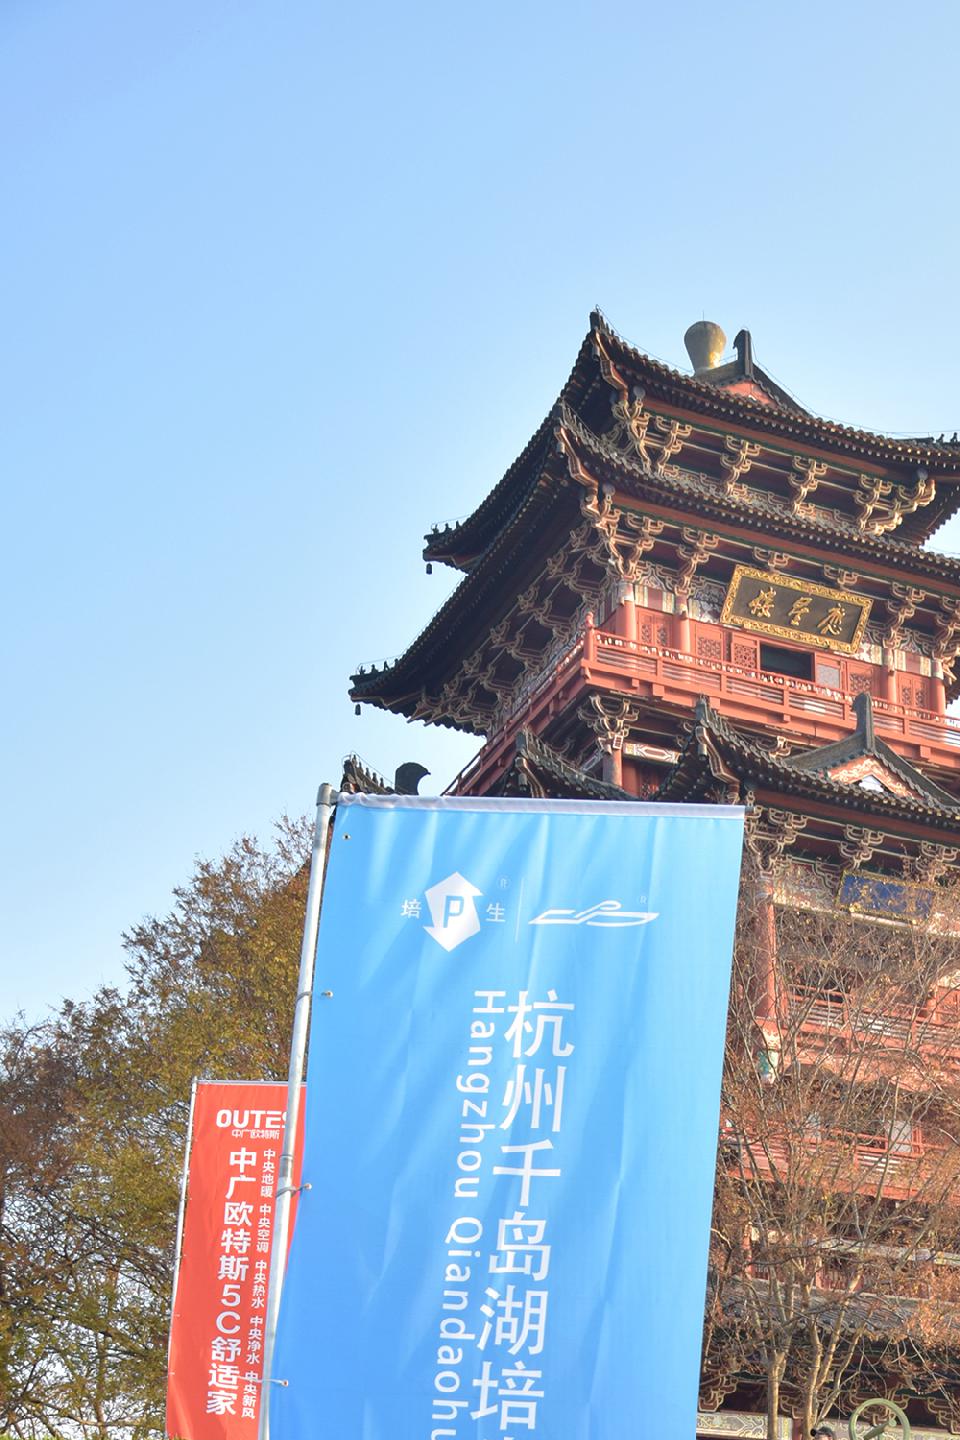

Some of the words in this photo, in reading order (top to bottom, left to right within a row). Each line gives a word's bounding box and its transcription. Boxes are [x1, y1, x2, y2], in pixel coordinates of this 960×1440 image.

[400, 899, 422, 919] 培
[486, 903, 506, 922] 生
[454, 989, 506, 1199] Hangzhou
[231, 1129, 280, 1140] 中广欧特斯
[260, 1148, 276, 1198] 中央地暖
[256, 1203, 272, 1253] 中央空调
[206, 1147, 257, 1416] 中广欧特斯5C舒适家
[251, 1260, 268, 1309] 中央热水
[245, 1315, 263, 1365] 中央净水
[241, 1370, 259, 1419] 中央新风
